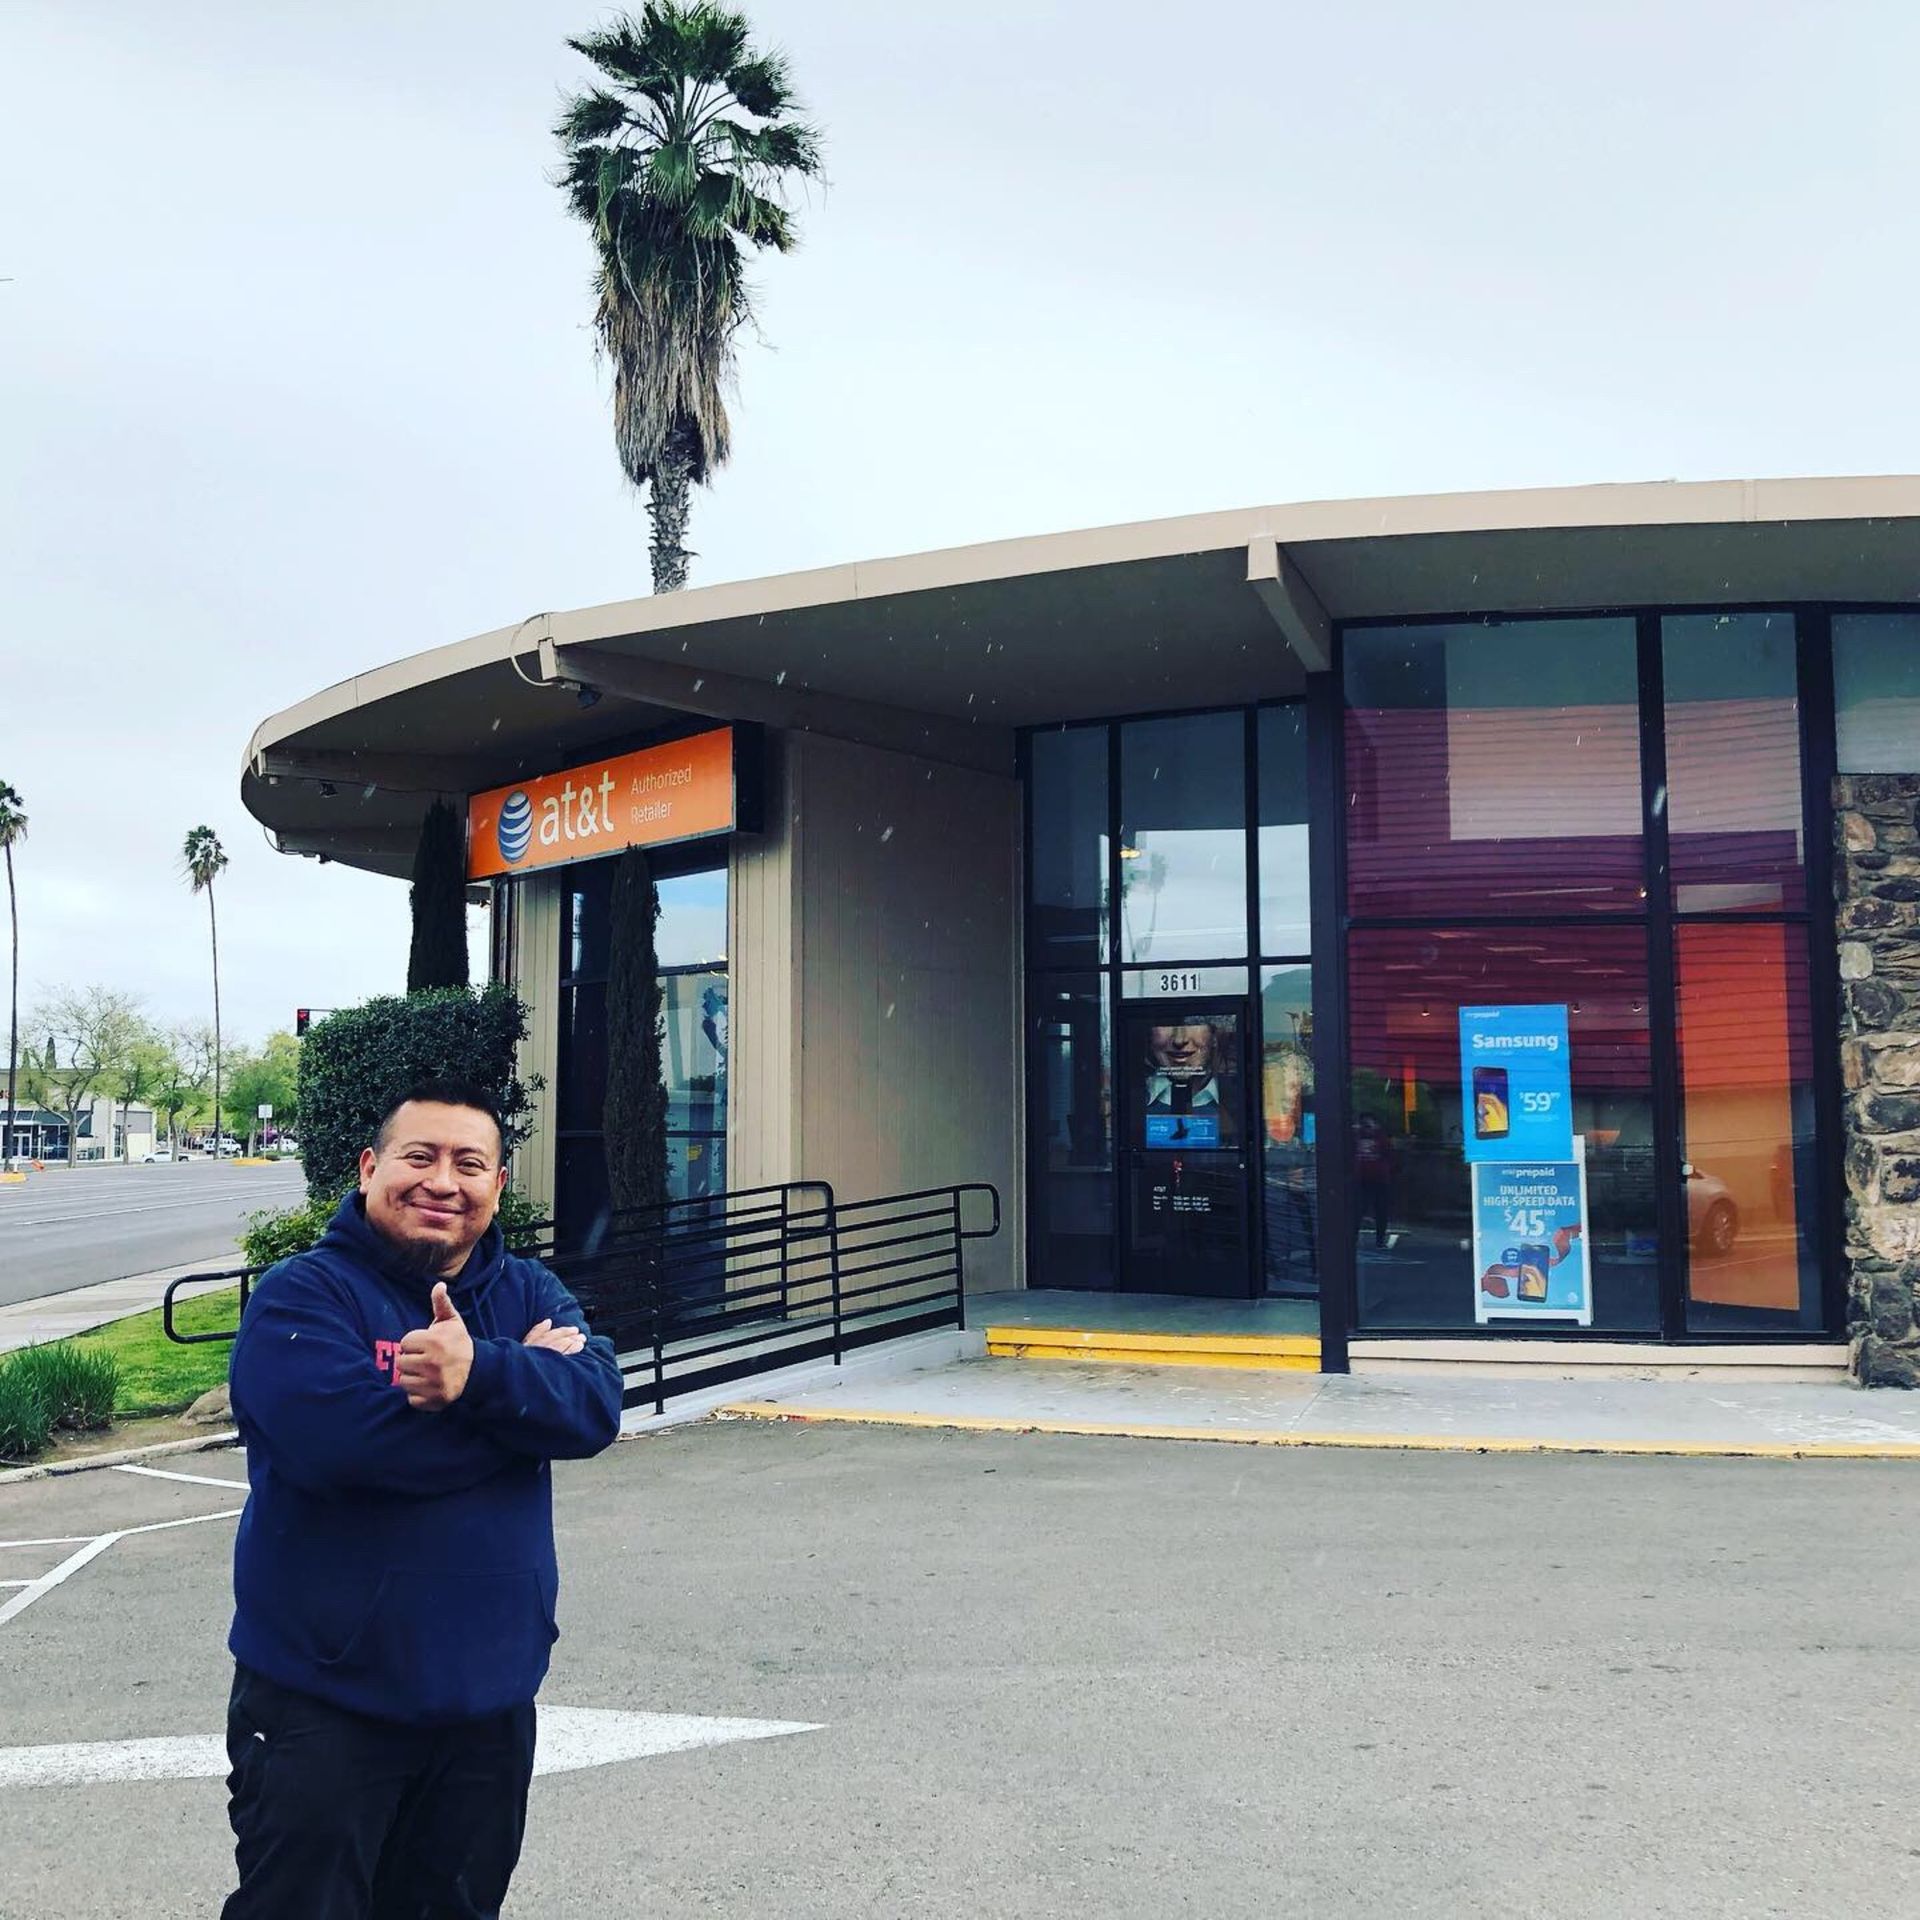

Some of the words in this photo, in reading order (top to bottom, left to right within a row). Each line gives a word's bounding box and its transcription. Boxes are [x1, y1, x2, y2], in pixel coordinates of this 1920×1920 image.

[631, 763, 692, 795] Authorized
[539, 770, 616, 846] at&t
[631, 801, 673, 824] Retailer
[1160, 973, 1198, 992] 3611
[1472, 1033, 1559, 1051] Samsung
[1500, 1185, 1558, 1196] UNLIMITED
[1547, 1195, 1576, 1207] DATA
